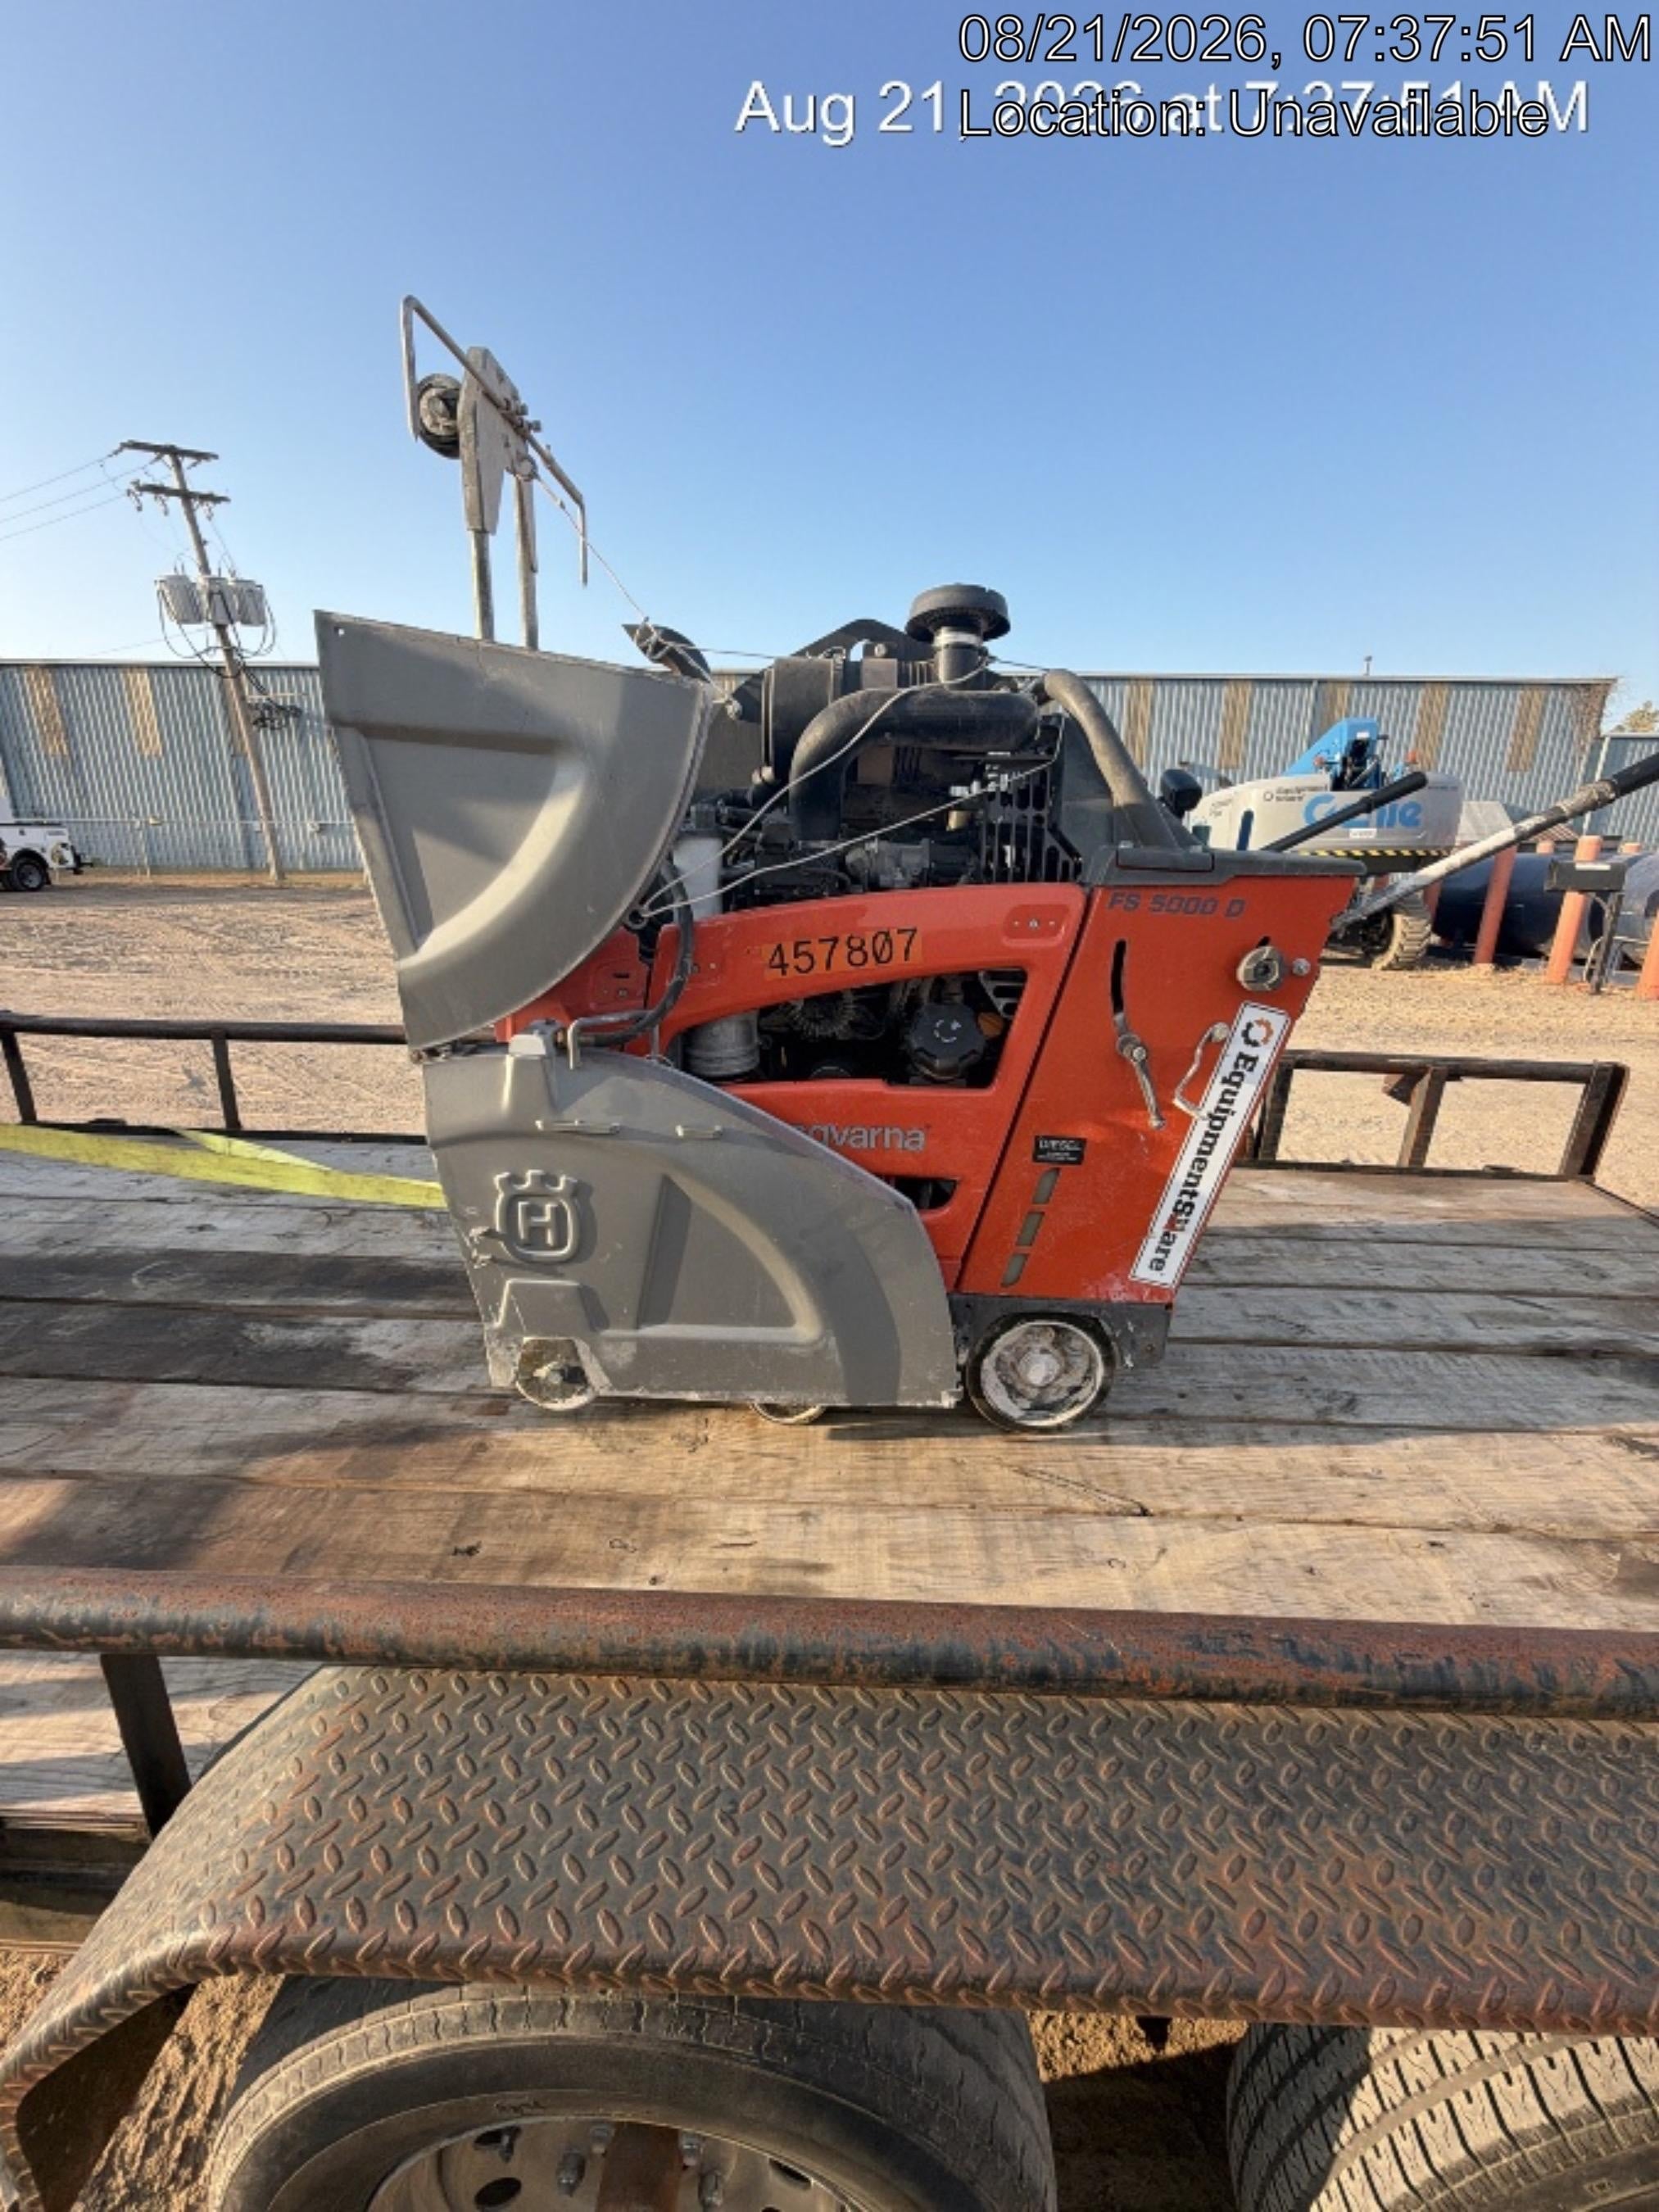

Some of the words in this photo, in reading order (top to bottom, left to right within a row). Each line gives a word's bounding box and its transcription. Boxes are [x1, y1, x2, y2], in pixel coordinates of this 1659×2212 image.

[1108, 891, 1141, 912] FS
[1150, 894, 1219, 915] 5000
[1226, 898, 1246, 918] D
[768, 927, 918, 976] 457807
